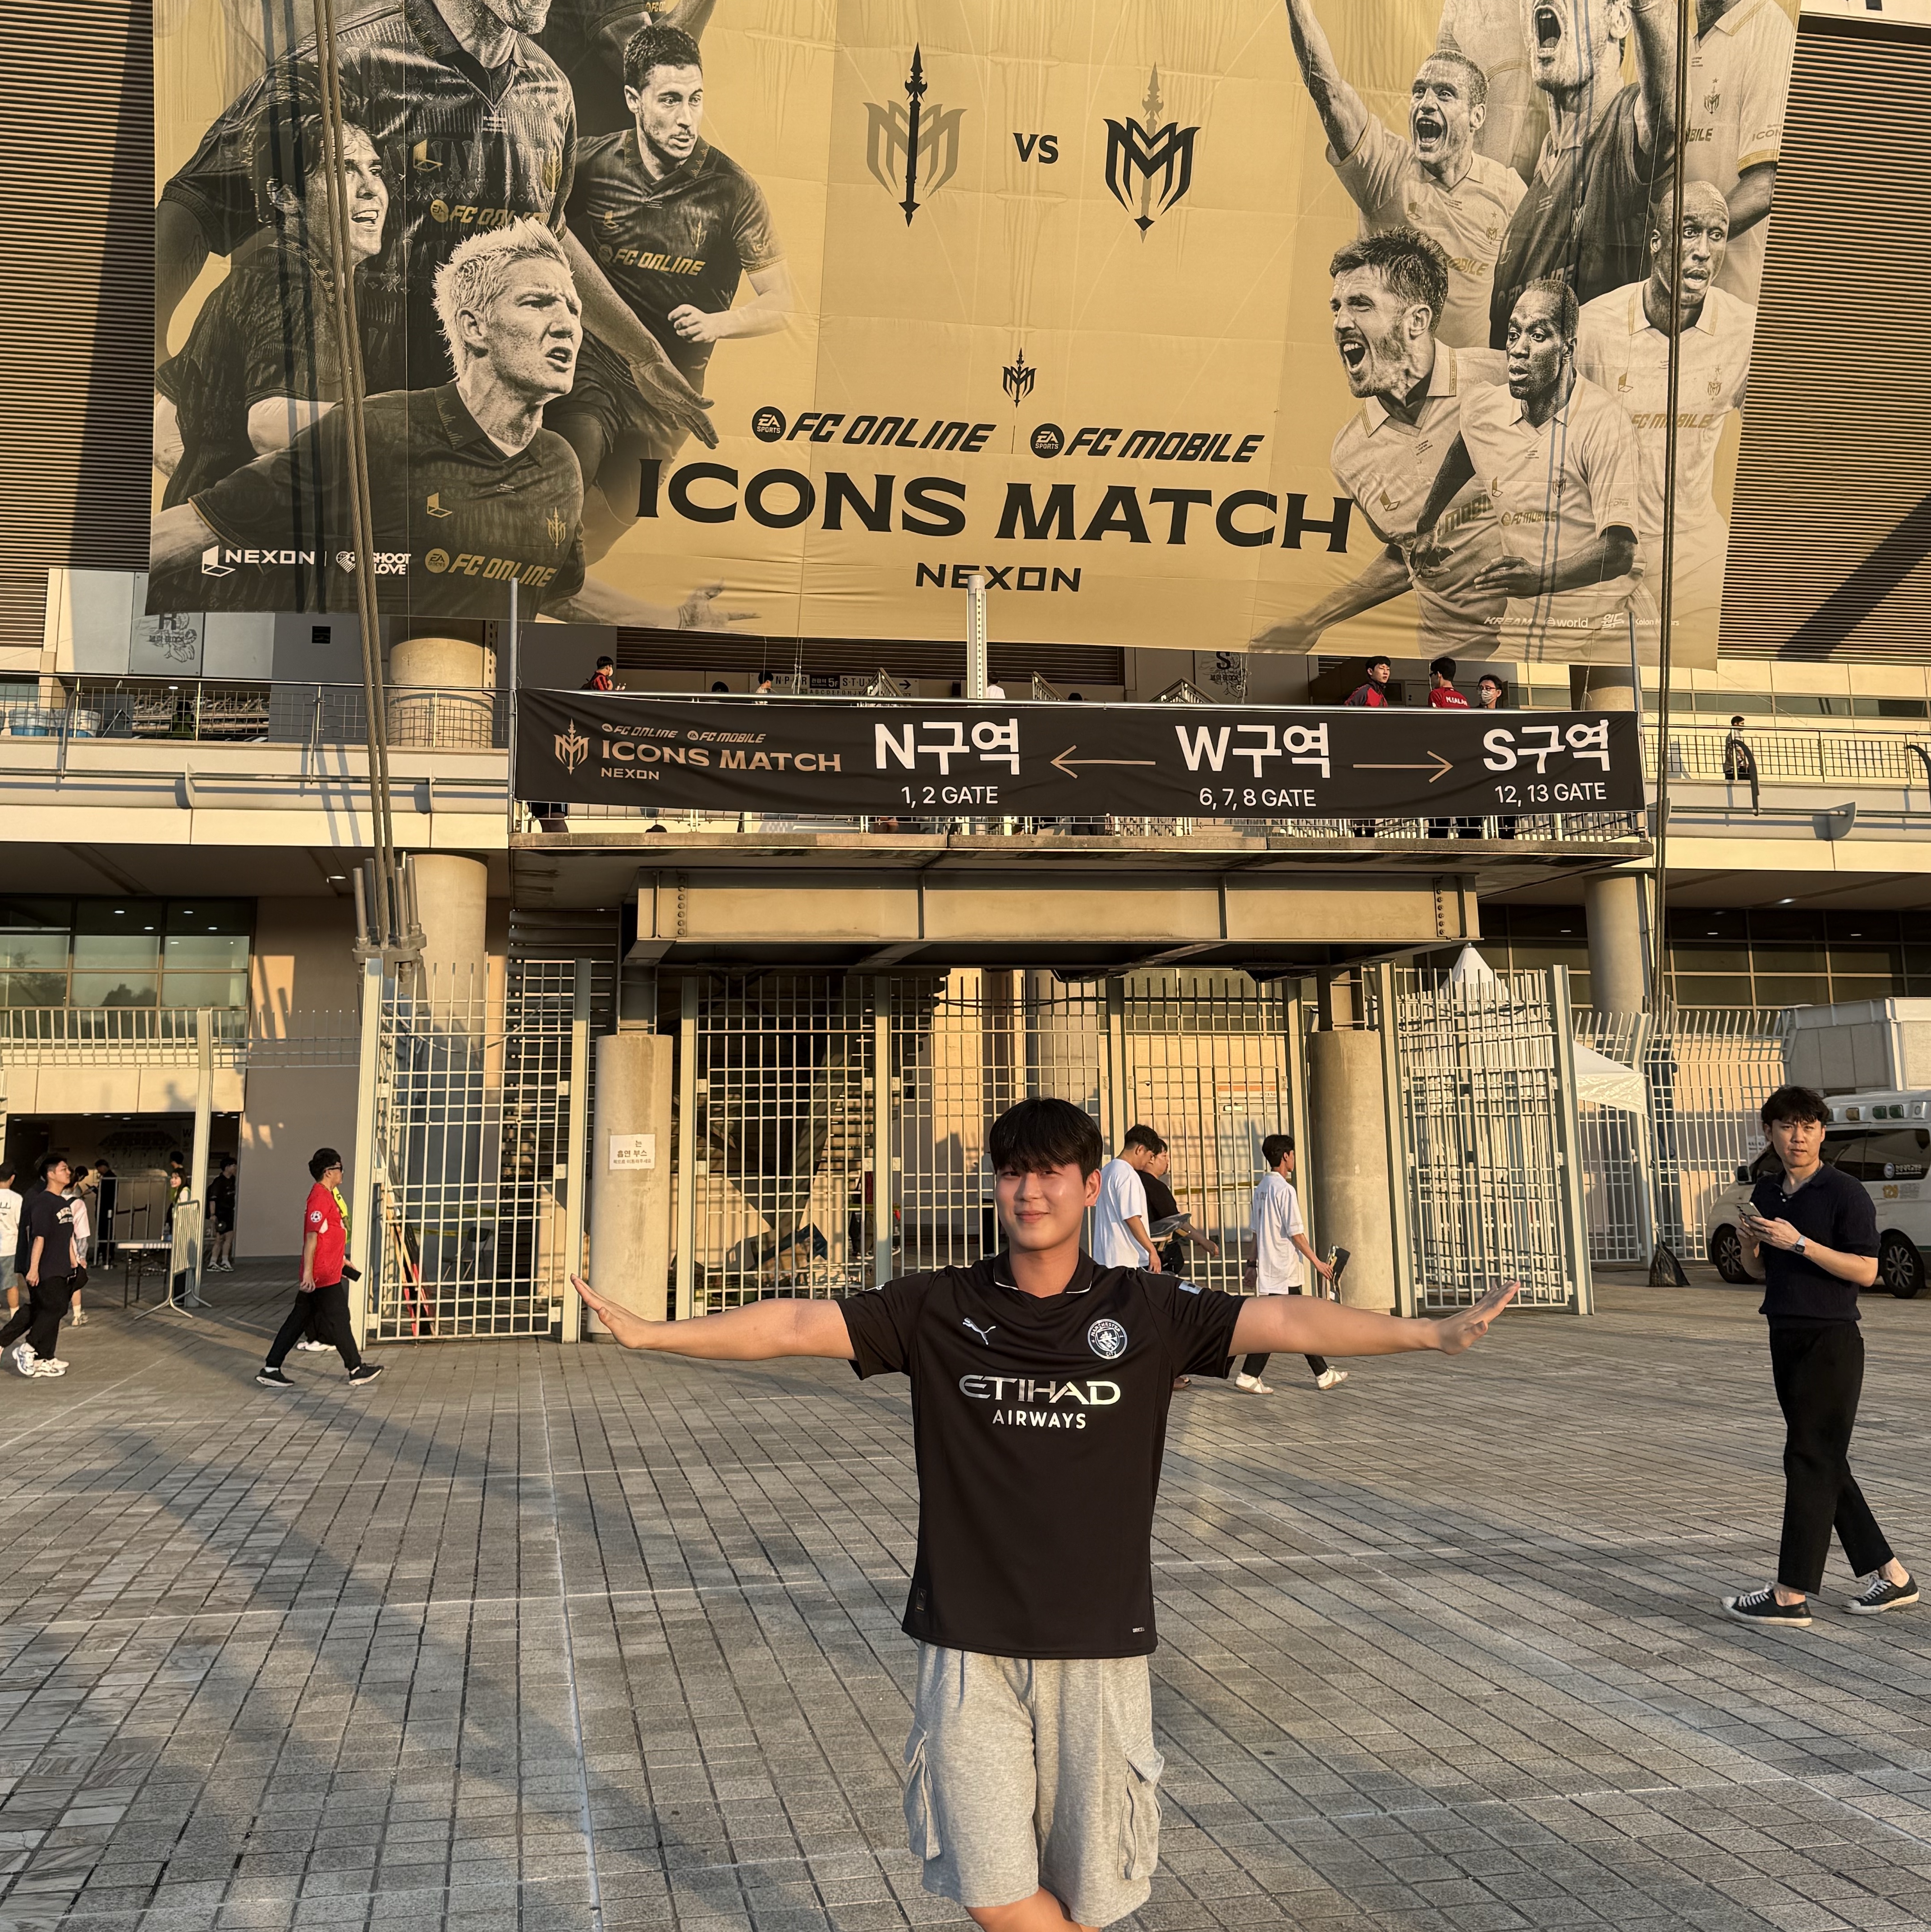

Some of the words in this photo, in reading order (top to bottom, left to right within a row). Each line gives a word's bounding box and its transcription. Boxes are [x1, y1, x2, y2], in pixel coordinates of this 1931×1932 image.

[1686, 128, 1713, 142] BILE
[1012, 132, 1059, 164] VS
[449, 205, 478, 223] FC
[613, 248, 638, 266] FC
[637, 252, 706, 275] ONLINE
[1447, 257, 1489, 277] OBILE
[757, 414, 780, 428] EA
[1649, 413, 1715, 429] MBILE
[785, 412, 846, 442] FC
[842, 415, 997, 452] ONLINE
[1036, 431, 1059, 443] EA
[1064, 428, 1124, 456] FC
[1117, 430, 1265, 463] MOBILE
[635, 458, 967, 537] ICONS
[994, 482, 1354, 554] MATCH
[225, 549, 315, 564] NEXON
[448, 553, 485, 576] FC
[482, 558, 558, 587] ONLINE
[915, 562, 1081, 592] NEXON
[1484, 616, 1533, 626] KREAM
[1216, 651, 1231, 670] S
[828, 678, 839, 687] 5F
[614, 725, 631, 735] FC
[631, 726, 679, 739] ONLINE
[699, 732, 716, 741] FC
[716, 732, 766, 743] MOBILE
[602, 739, 710, 766] ICONS
[719, 749, 842, 772] MATCH
[875, 718, 1020, 775] N구역
[1174, 722, 1330, 778] W구역
[1483, 719, 1610, 774] S구역
[601, 767, 659, 780] NEXON
[922, 786, 936, 804] 2
[941, 786, 998, 804] GATE
[1243, 789, 1257, 807] 8
[1261, 789, 1316, 807] GATE
[1495, 785, 1522, 807] 12,
[1527, 784, 1549, 803] 13
[1554, 782, 1607, 802] GATE
[633, 1149, 647, 1157] 부스
[959, 1374, 1121, 1405] ETIHAD
[992, 1409, 1087, 1429] AIRWAYS
